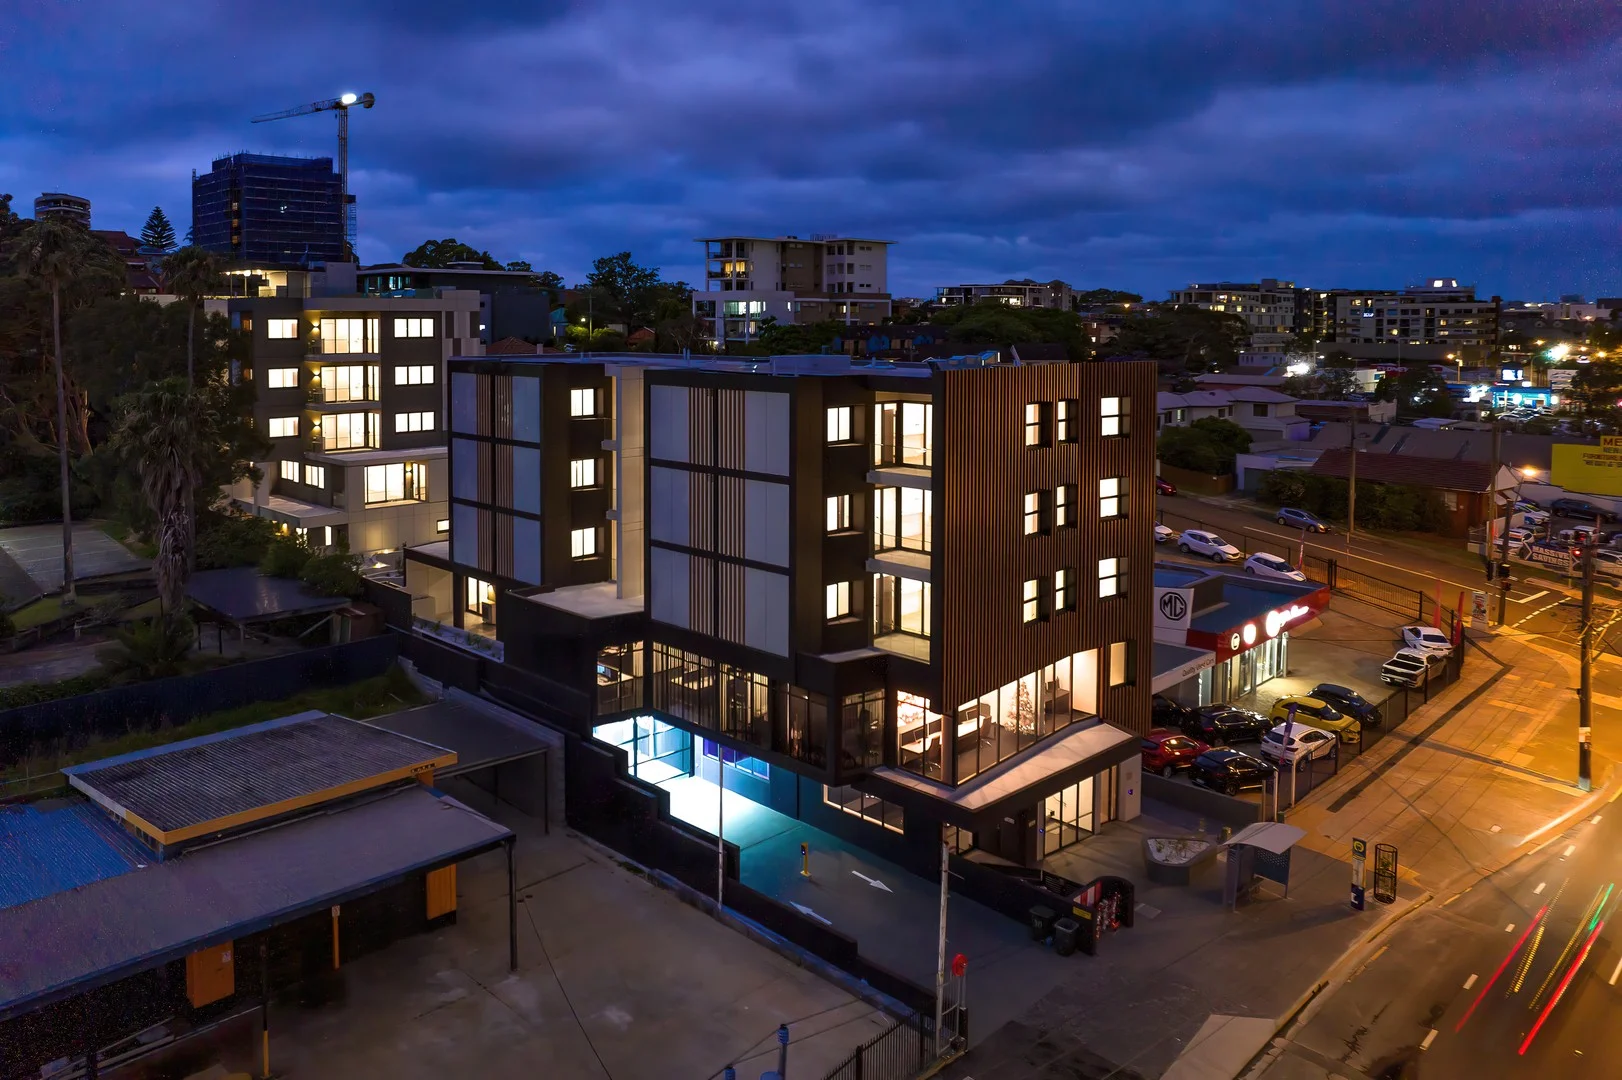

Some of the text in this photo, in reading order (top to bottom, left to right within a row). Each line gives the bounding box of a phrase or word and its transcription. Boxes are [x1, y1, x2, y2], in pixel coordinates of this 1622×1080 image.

[1532, 546, 1569, 560] MASSIVE
[1532, 553, 1569, 566] SAVINGS
[1162, 594, 1185, 618] MG
